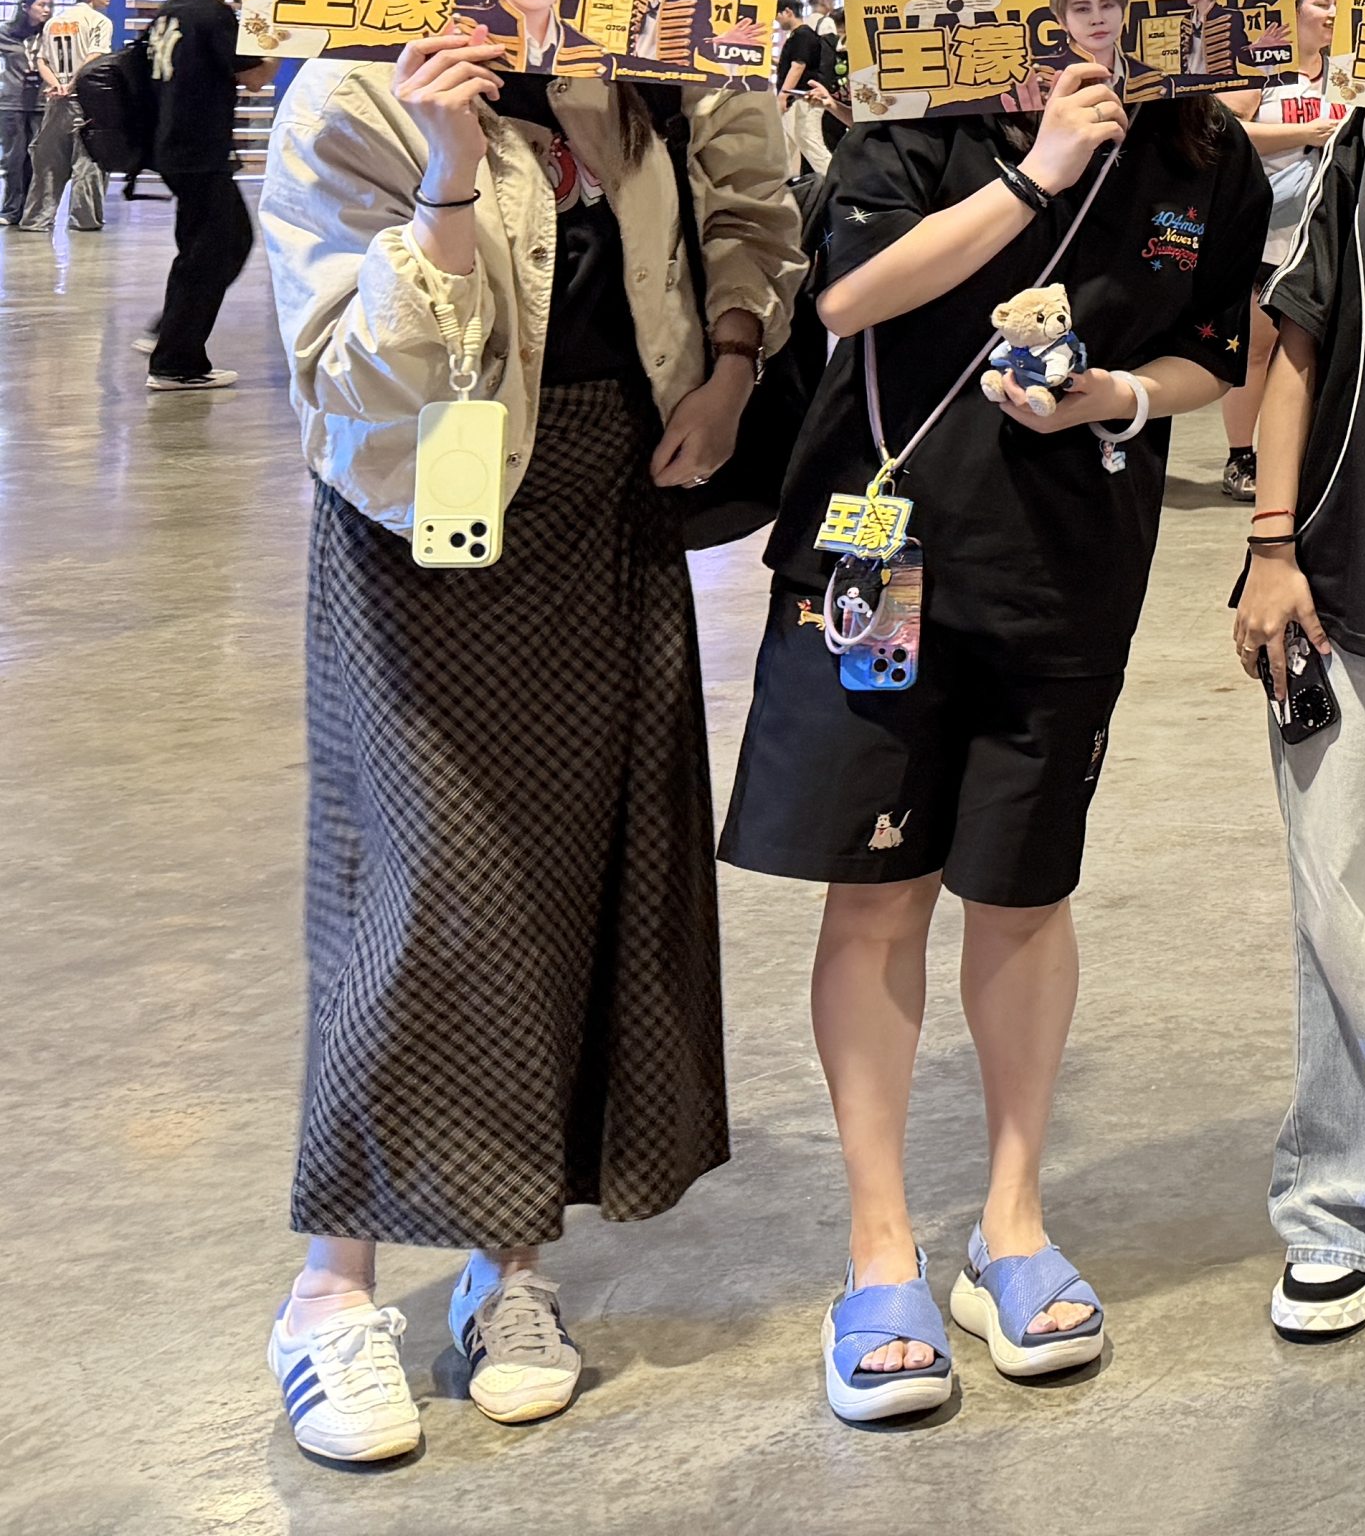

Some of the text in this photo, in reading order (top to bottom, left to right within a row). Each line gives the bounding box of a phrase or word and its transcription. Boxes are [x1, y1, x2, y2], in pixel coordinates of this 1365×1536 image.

[864, 4, 898, 15] WANG
[878, 23, 1031, 91] 王濛
[820, 503, 899, 550] 王濛
